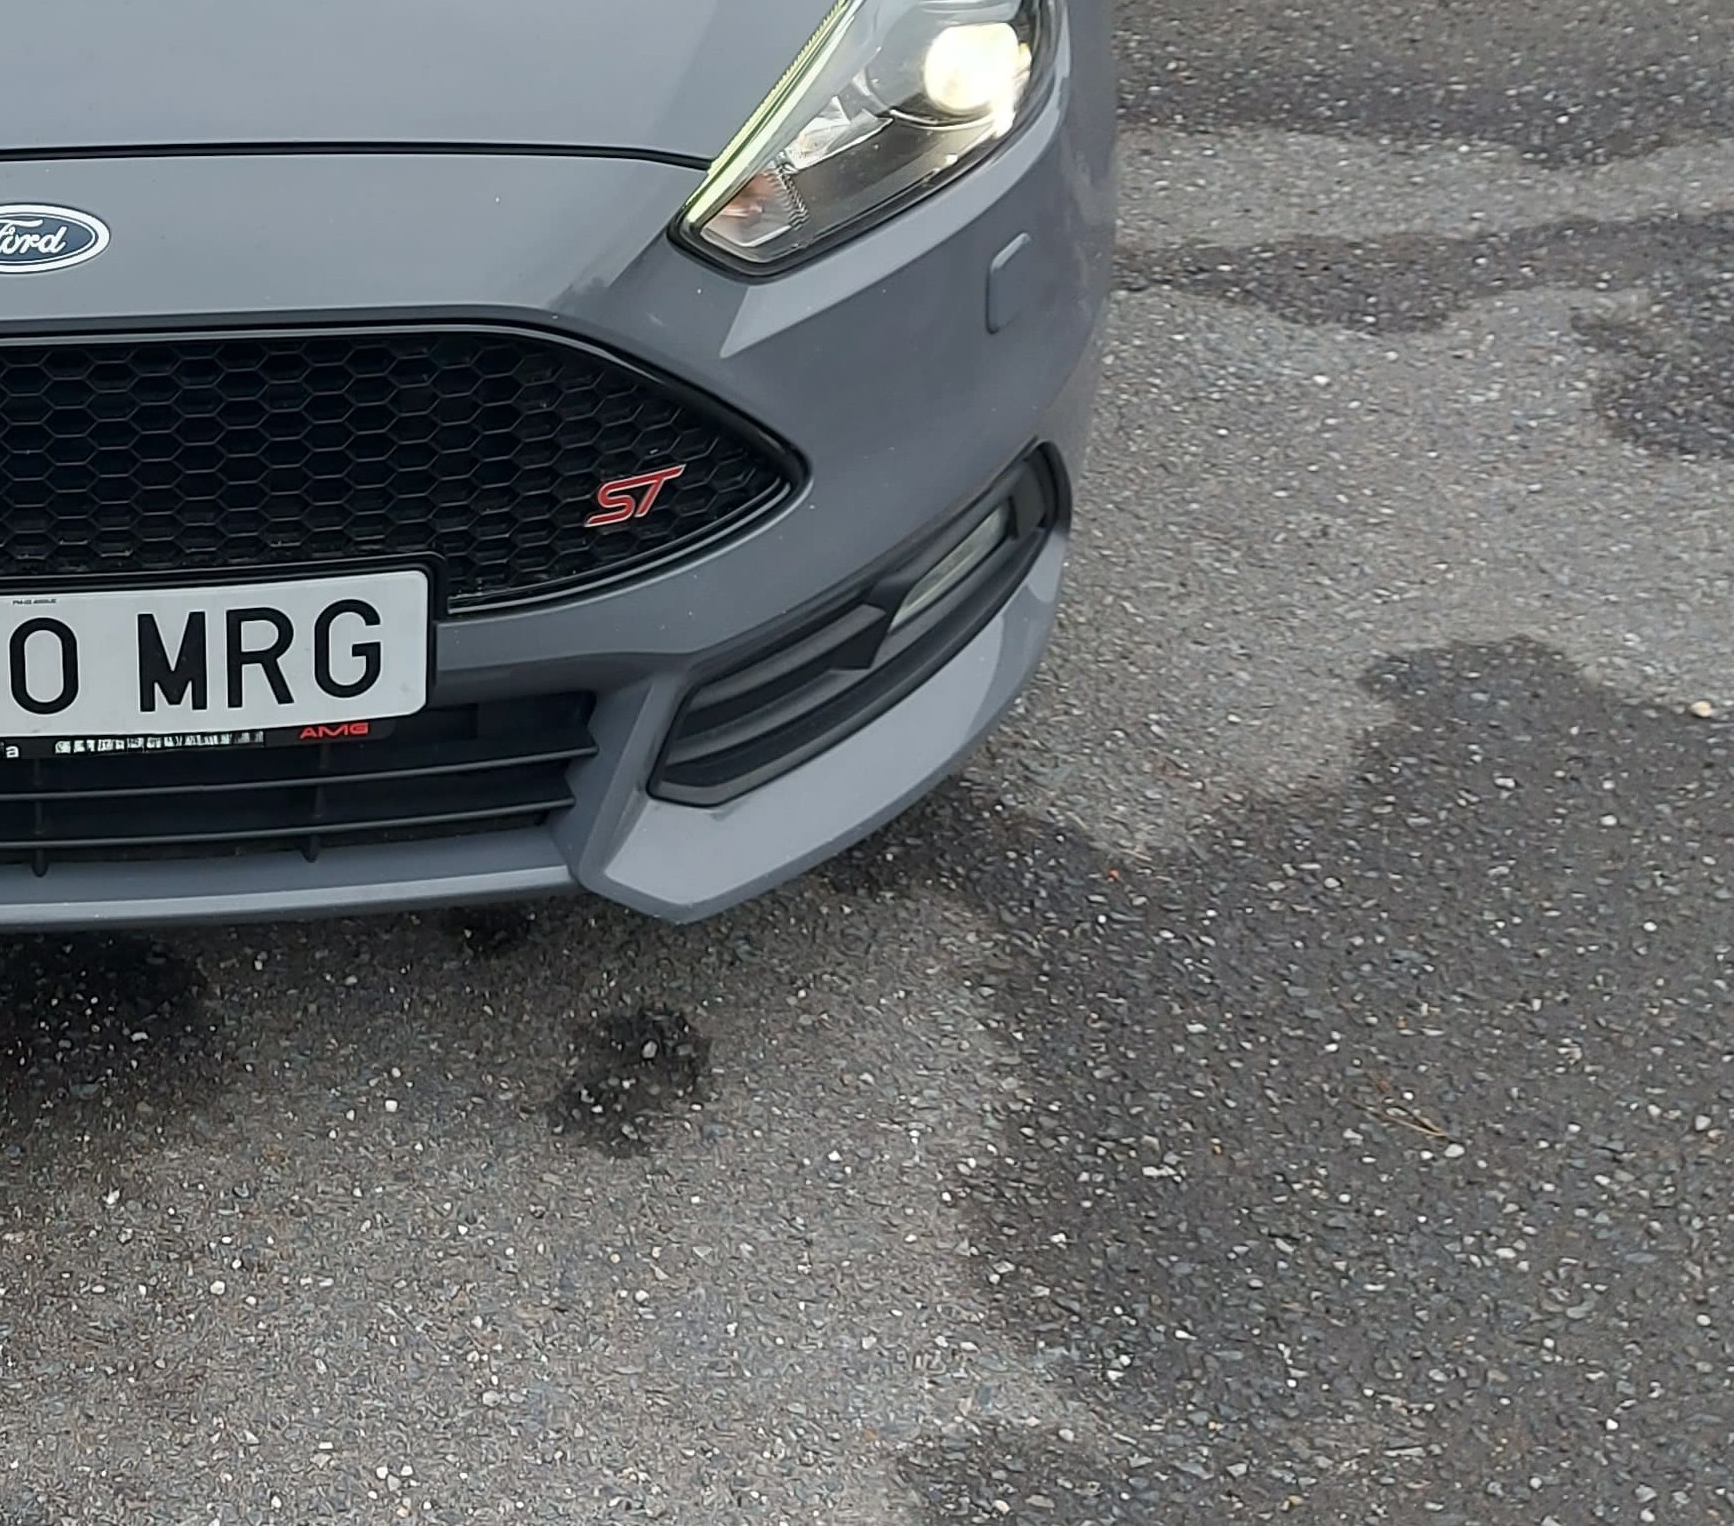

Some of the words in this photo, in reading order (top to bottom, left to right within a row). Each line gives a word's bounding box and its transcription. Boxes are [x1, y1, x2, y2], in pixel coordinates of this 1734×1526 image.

[584, 464, 687, 527] ST
[137, 598, 382, 713] MRG
[299, 721, 370, 740] AMG
